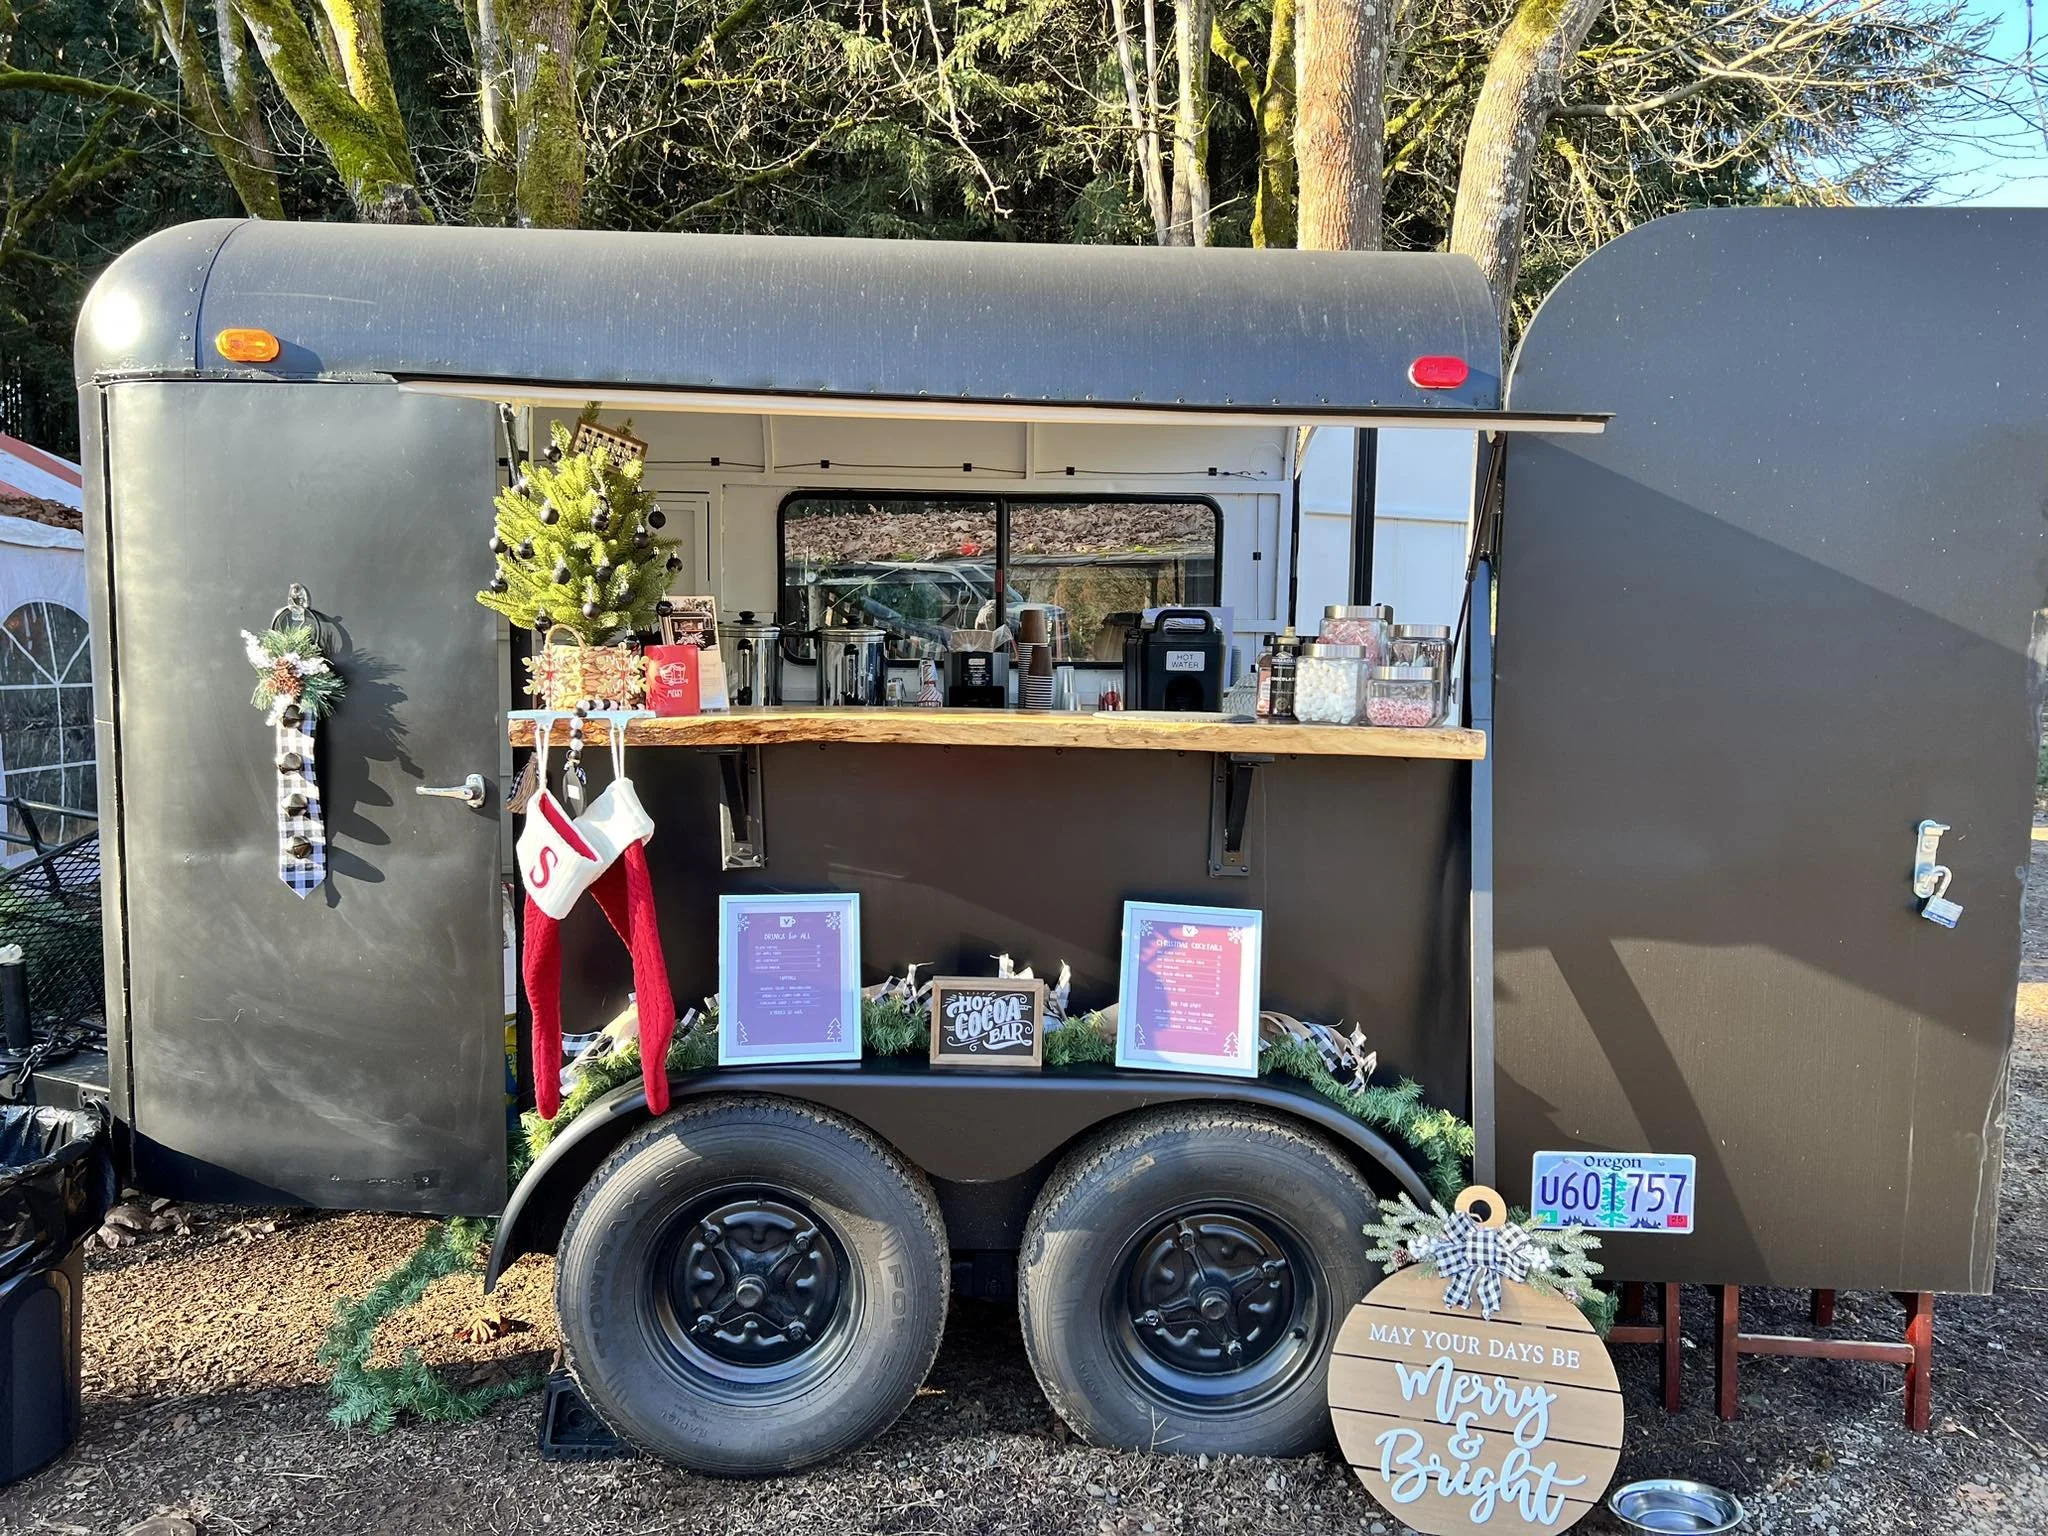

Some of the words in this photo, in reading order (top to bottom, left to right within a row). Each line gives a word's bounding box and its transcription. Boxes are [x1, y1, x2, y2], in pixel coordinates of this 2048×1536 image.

[1171, 661, 1199, 669] WATER
[529, 846, 558, 889] S
[1156, 939, 1189, 949] CHRISTMAS
[1191, 942, 1223, 952] COCKTAILS
[947, 995, 993, 1016] HOT
[955, 997, 1021, 1041] COCOA
[983, 1022, 1033, 1050] BAR
[1584, 1155, 1642, 1171] Oregon
[1541, 1171, 1688, 1214] U601757
[1368, 1323, 1417, 1346] MAY
[1422, 1329, 1481, 1356] YOUR
[1489, 1339, 1545, 1365] DAYS
[1551, 1347, 1581, 1369] BE
[1395, 1355, 1558, 1450] Merry
[1447, 1411, 1485, 1461] &
[1374, 1427, 1587, 1525] Bright
